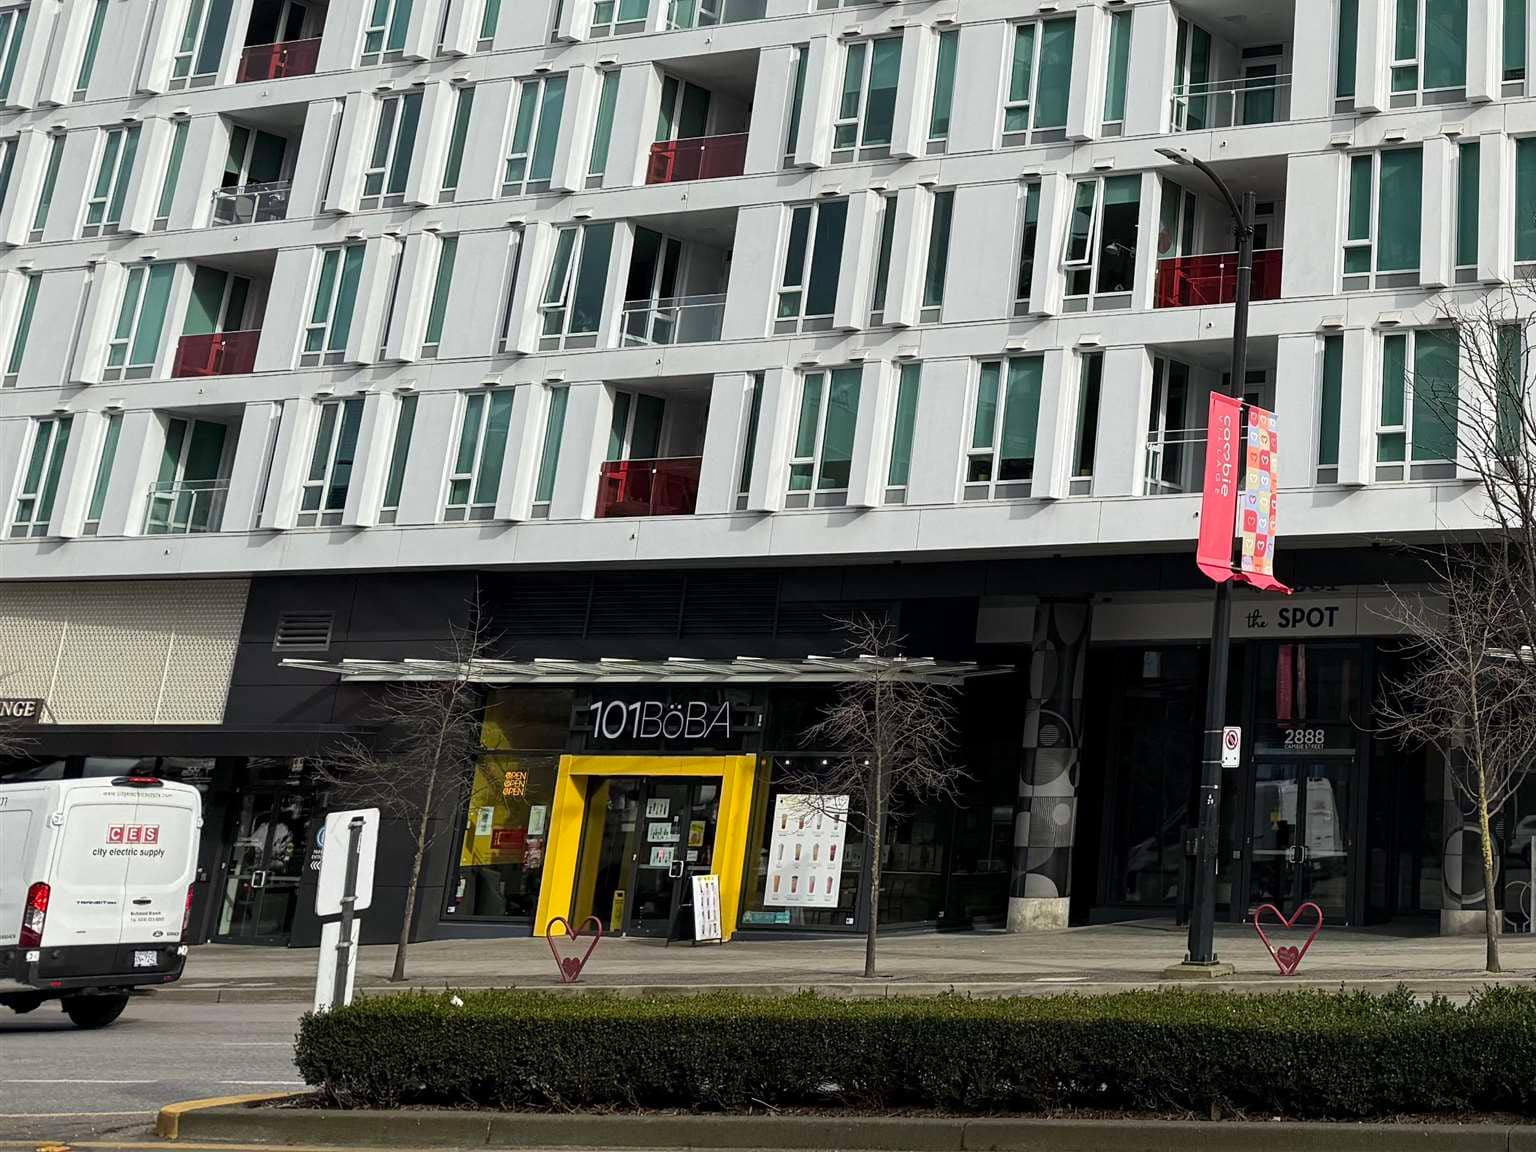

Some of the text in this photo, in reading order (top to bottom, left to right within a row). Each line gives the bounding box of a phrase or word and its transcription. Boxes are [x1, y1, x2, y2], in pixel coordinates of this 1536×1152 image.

[1215, 415, 1224, 494] VILLAGE
[1244, 606, 1339, 628] the SPOT
[1284, 729, 1325, 744] 2888
[109, 827, 157, 841] CES
[92, 848, 166, 859] city electric supply
